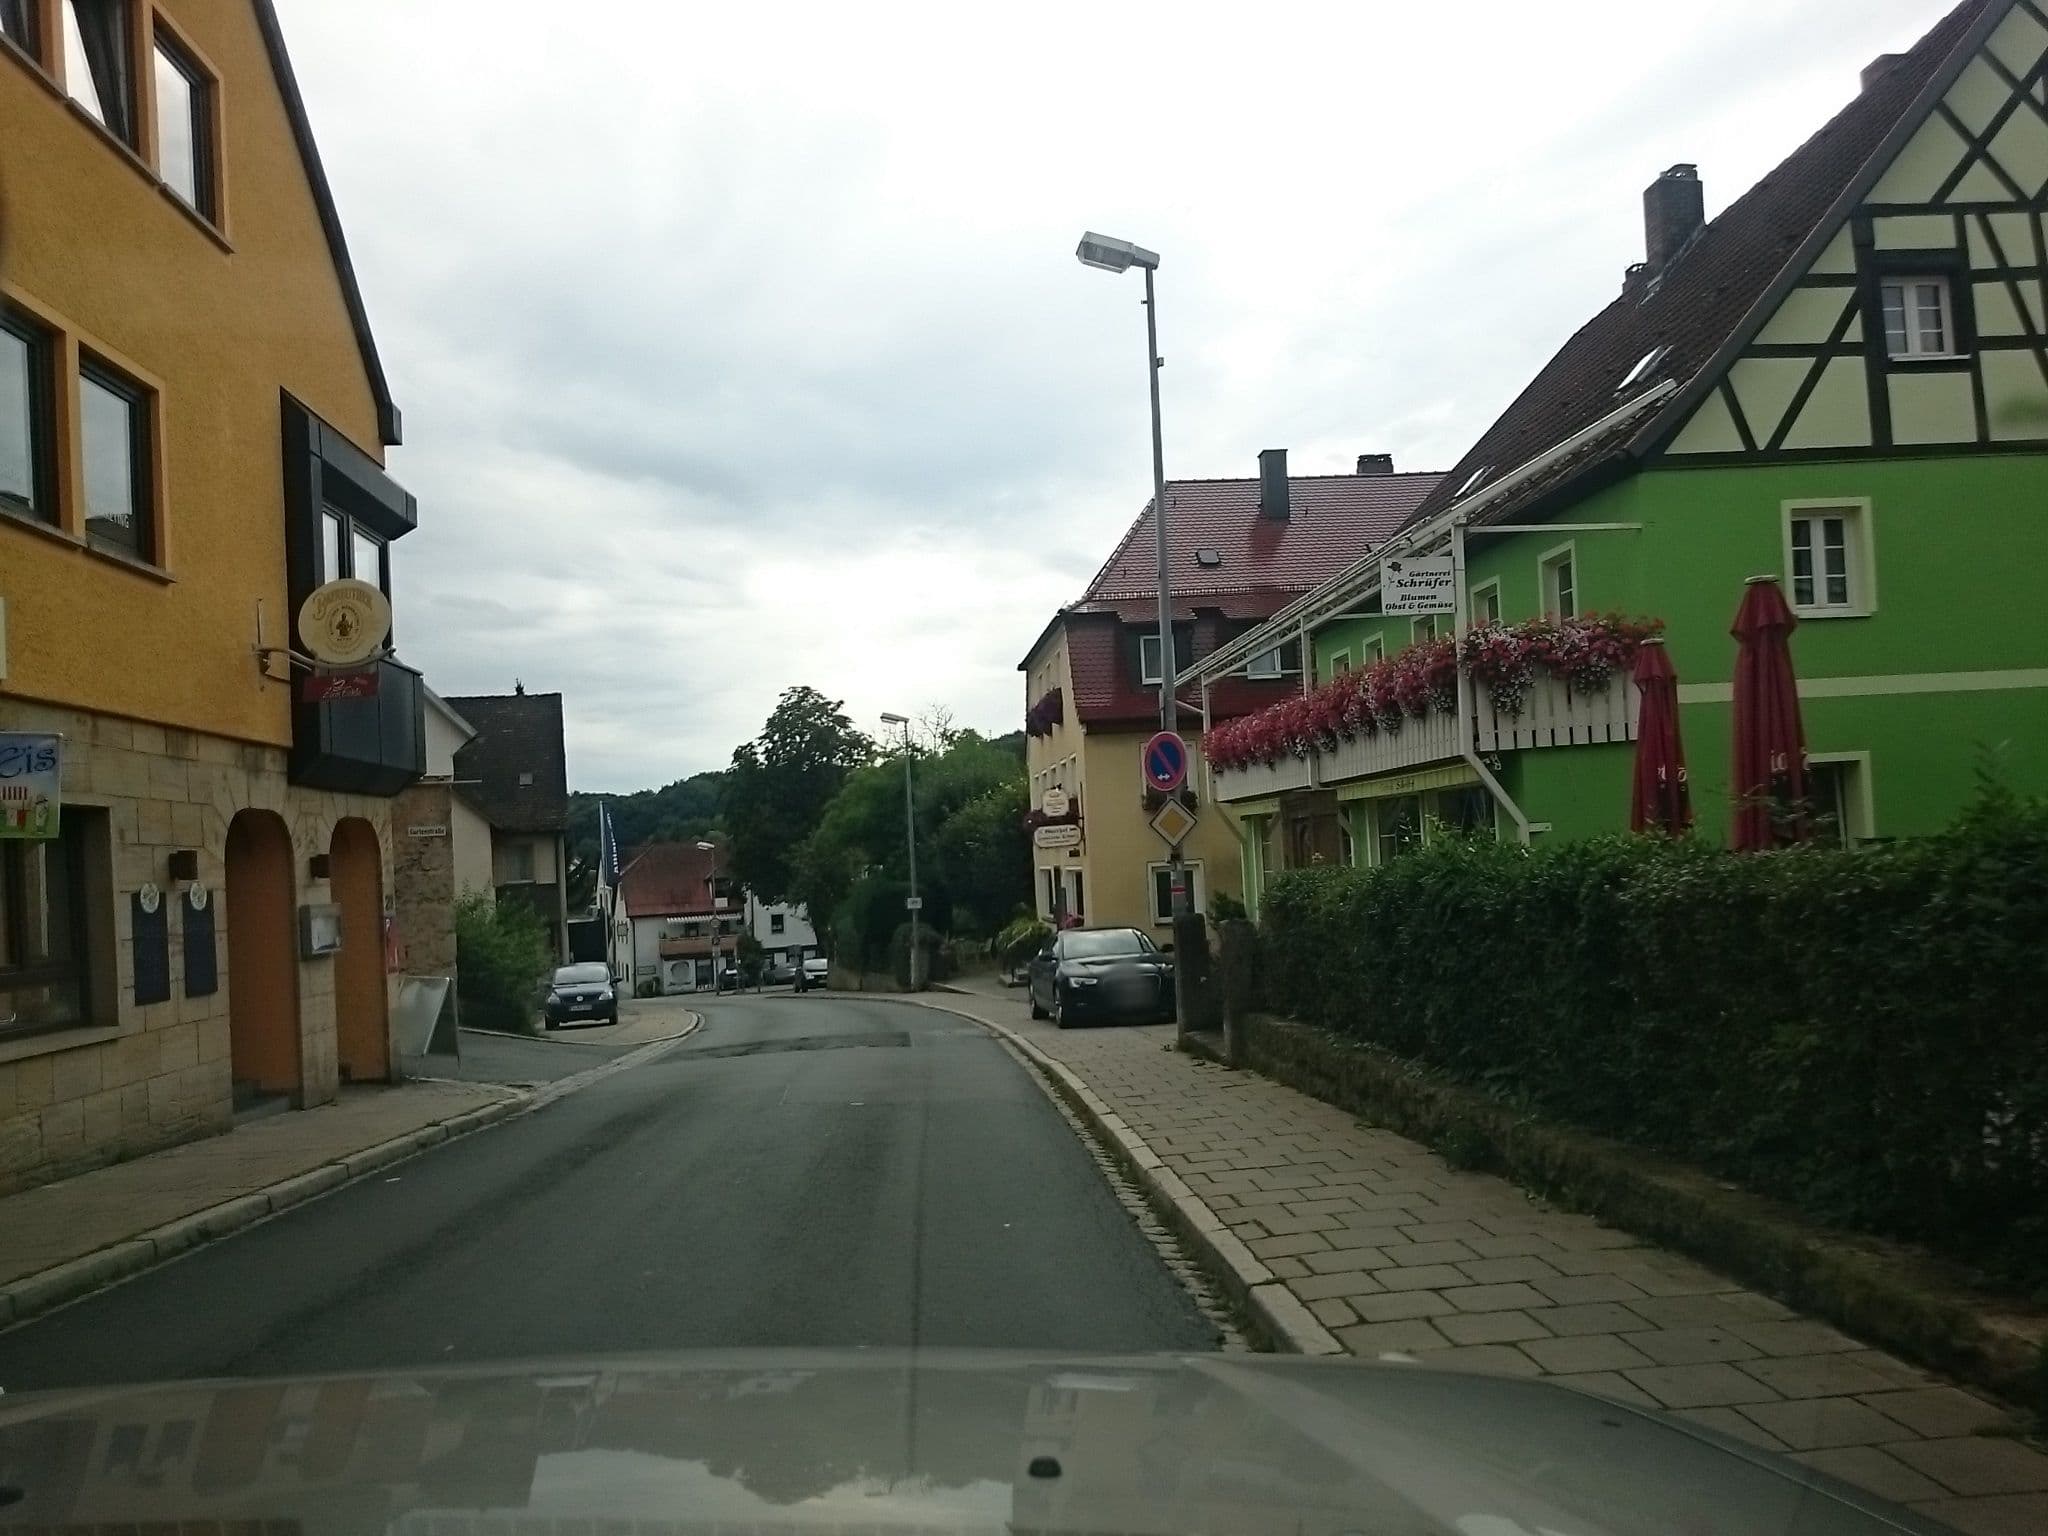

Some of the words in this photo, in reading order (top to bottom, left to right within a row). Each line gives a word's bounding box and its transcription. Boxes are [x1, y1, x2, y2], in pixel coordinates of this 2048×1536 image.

[1396, 577, 1452, 590] Schrüfer
[1400, 593, 1438, 602] Blumen
[1385, 602, 1406, 611] Obst
[1408, 602, 1416, 610] &
[1417, 601, 1453, 609] Gemüse
[0, 745, 56, 779] Eis
